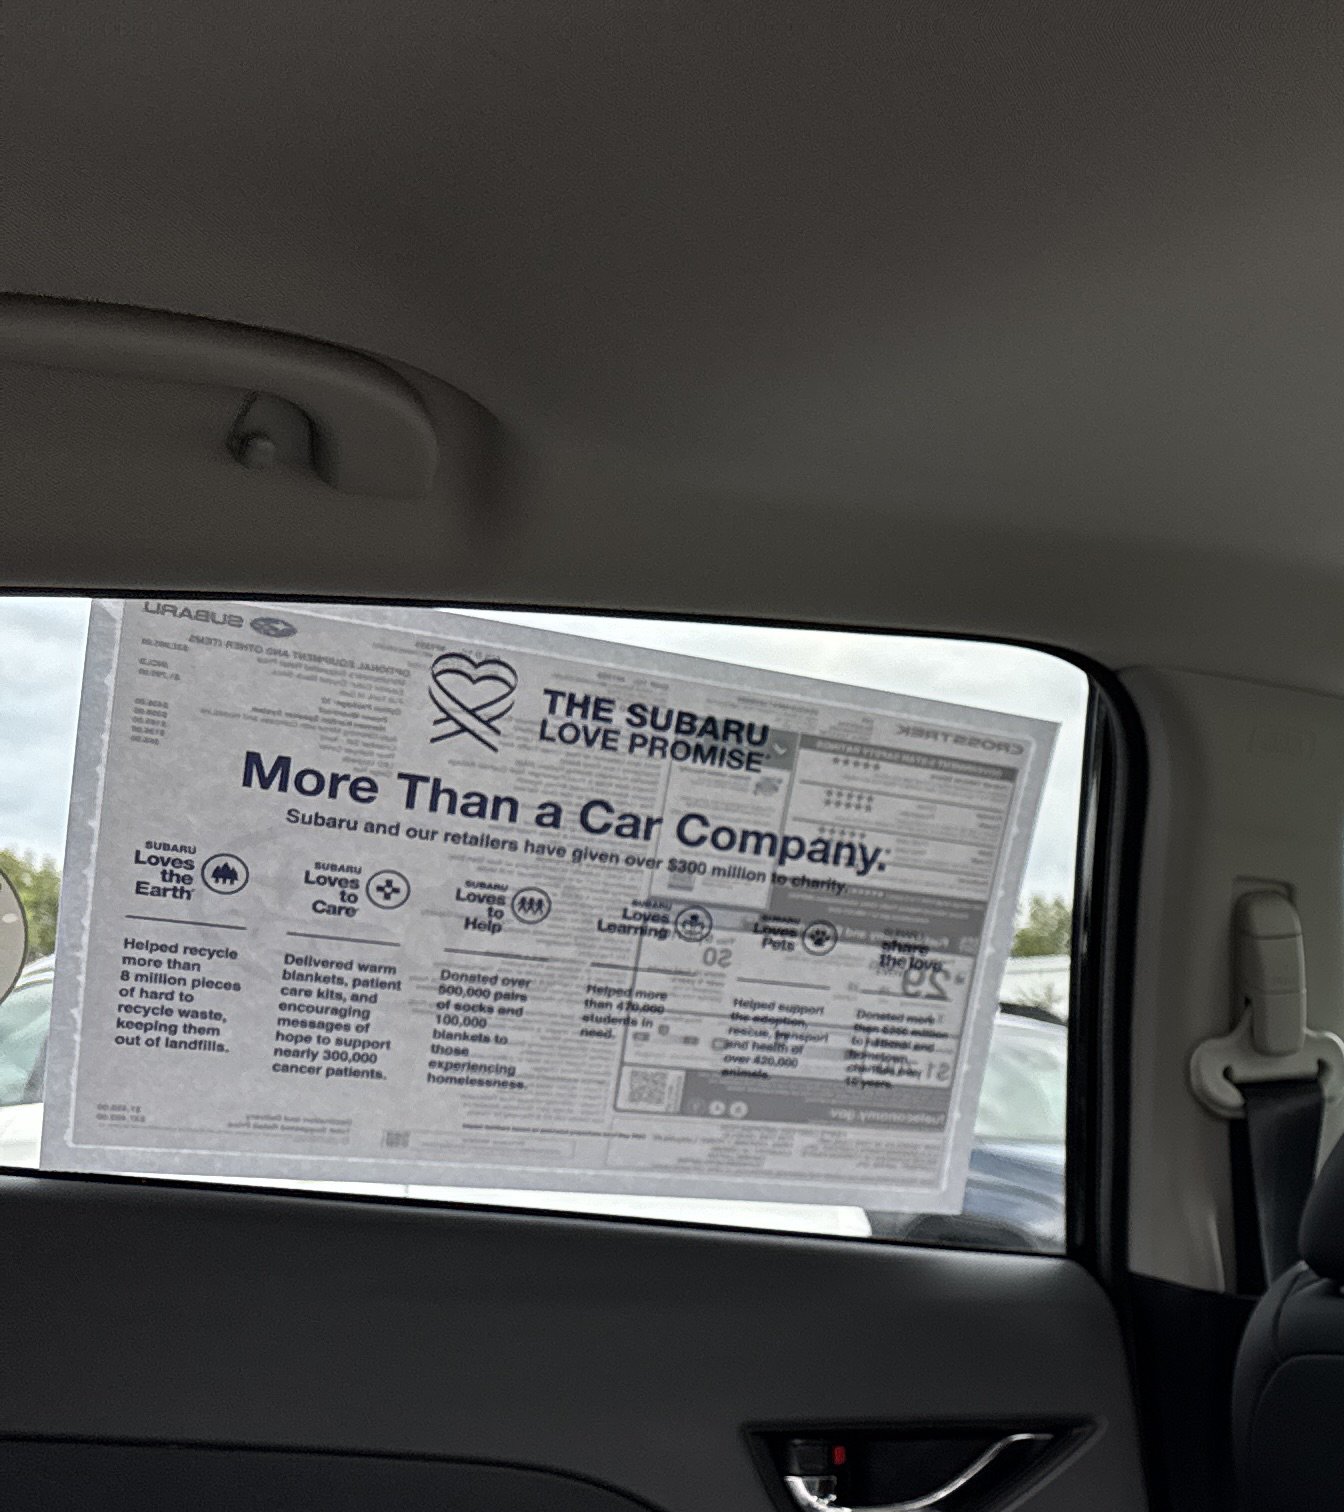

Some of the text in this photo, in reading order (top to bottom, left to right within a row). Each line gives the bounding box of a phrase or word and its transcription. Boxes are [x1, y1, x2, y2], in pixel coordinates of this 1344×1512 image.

[543, 689, 614, 723] THE
[625, 703, 770, 747] SUBARU
[538, 719, 621, 752] LOVE
[241, 751, 379, 803] More
[398, 772, 518, 824] Than
[534, 799, 562, 829] a
[579, 799, 664, 842] Car
[145, 840, 197, 855] SUBARU
[286, 808, 849, 896] Subaru and our retailers have given over $300 million to charity.
[134, 850, 195, 870] Loves
[314, 861, 363, 874] SUBARU
[160, 869, 193, 885] the
[304, 871, 360, 890] Loves
[464, 880, 509, 892] SUBARU
[135, 881, 192, 900] Earth
[339, 889, 358, 903] to
[456, 888, 506, 906] Loves
[312, 900, 358, 918] Care
[487, 906, 504, 920] to
[622, 908, 670, 924] Loves
[464, 917, 503, 935] Help
[597, 919, 668, 941] Learning
[753, 922, 798, 938] Loves
[124, 938, 238, 962] Helped recycle
[762, 937, 795, 952] Pets
[122, 956, 201, 972] more than
[284, 954, 397, 975] Delivered warm
[880, 954, 907, 970] the
[120, 970, 241, 992] 8 million pieces
[282, 969, 401, 992] blankets, patient
[440, 969, 532, 988] Donated over
[118, 986, 194, 1003] of hard to
[280, 986, 378, 1004] care kits, and
[493, 990, 528, 1003] pairs
[586, 984, 668, 1000] Helped more
[117, 1002, 227, 1024] recycle waste,
[278, 1001, 371, 1021] encouraging
[436, 1000, 524, 1018] of socks and
[584, 998, 612, 1010] than
[733, 997, 825, 1017] Helped support
[116, 1018, 221, 1037] keeping them
[277, 1016, 370, 1035] messages of
[435, 1014, 487, 1029] 100,000
[581, 1010, 653, 1027] students in
[114, 1033, 230, 1054] out of landfills.
[275, 1031, 391, 1053] hope to support
[432, 1028, 508, 1045] blankets to
[273, 1046, 378, 1065] nearly 300,000
[431, 1044, 469, 1057] those
[752, 1040, 787, 1054] health
[428, 1057, 517, 1077] experiencing
[723, 1055, 751, 1064] over
[272, 1062, 388, 1082] cancer patients.
[427, 1072, 528, 1090] homelessness.
